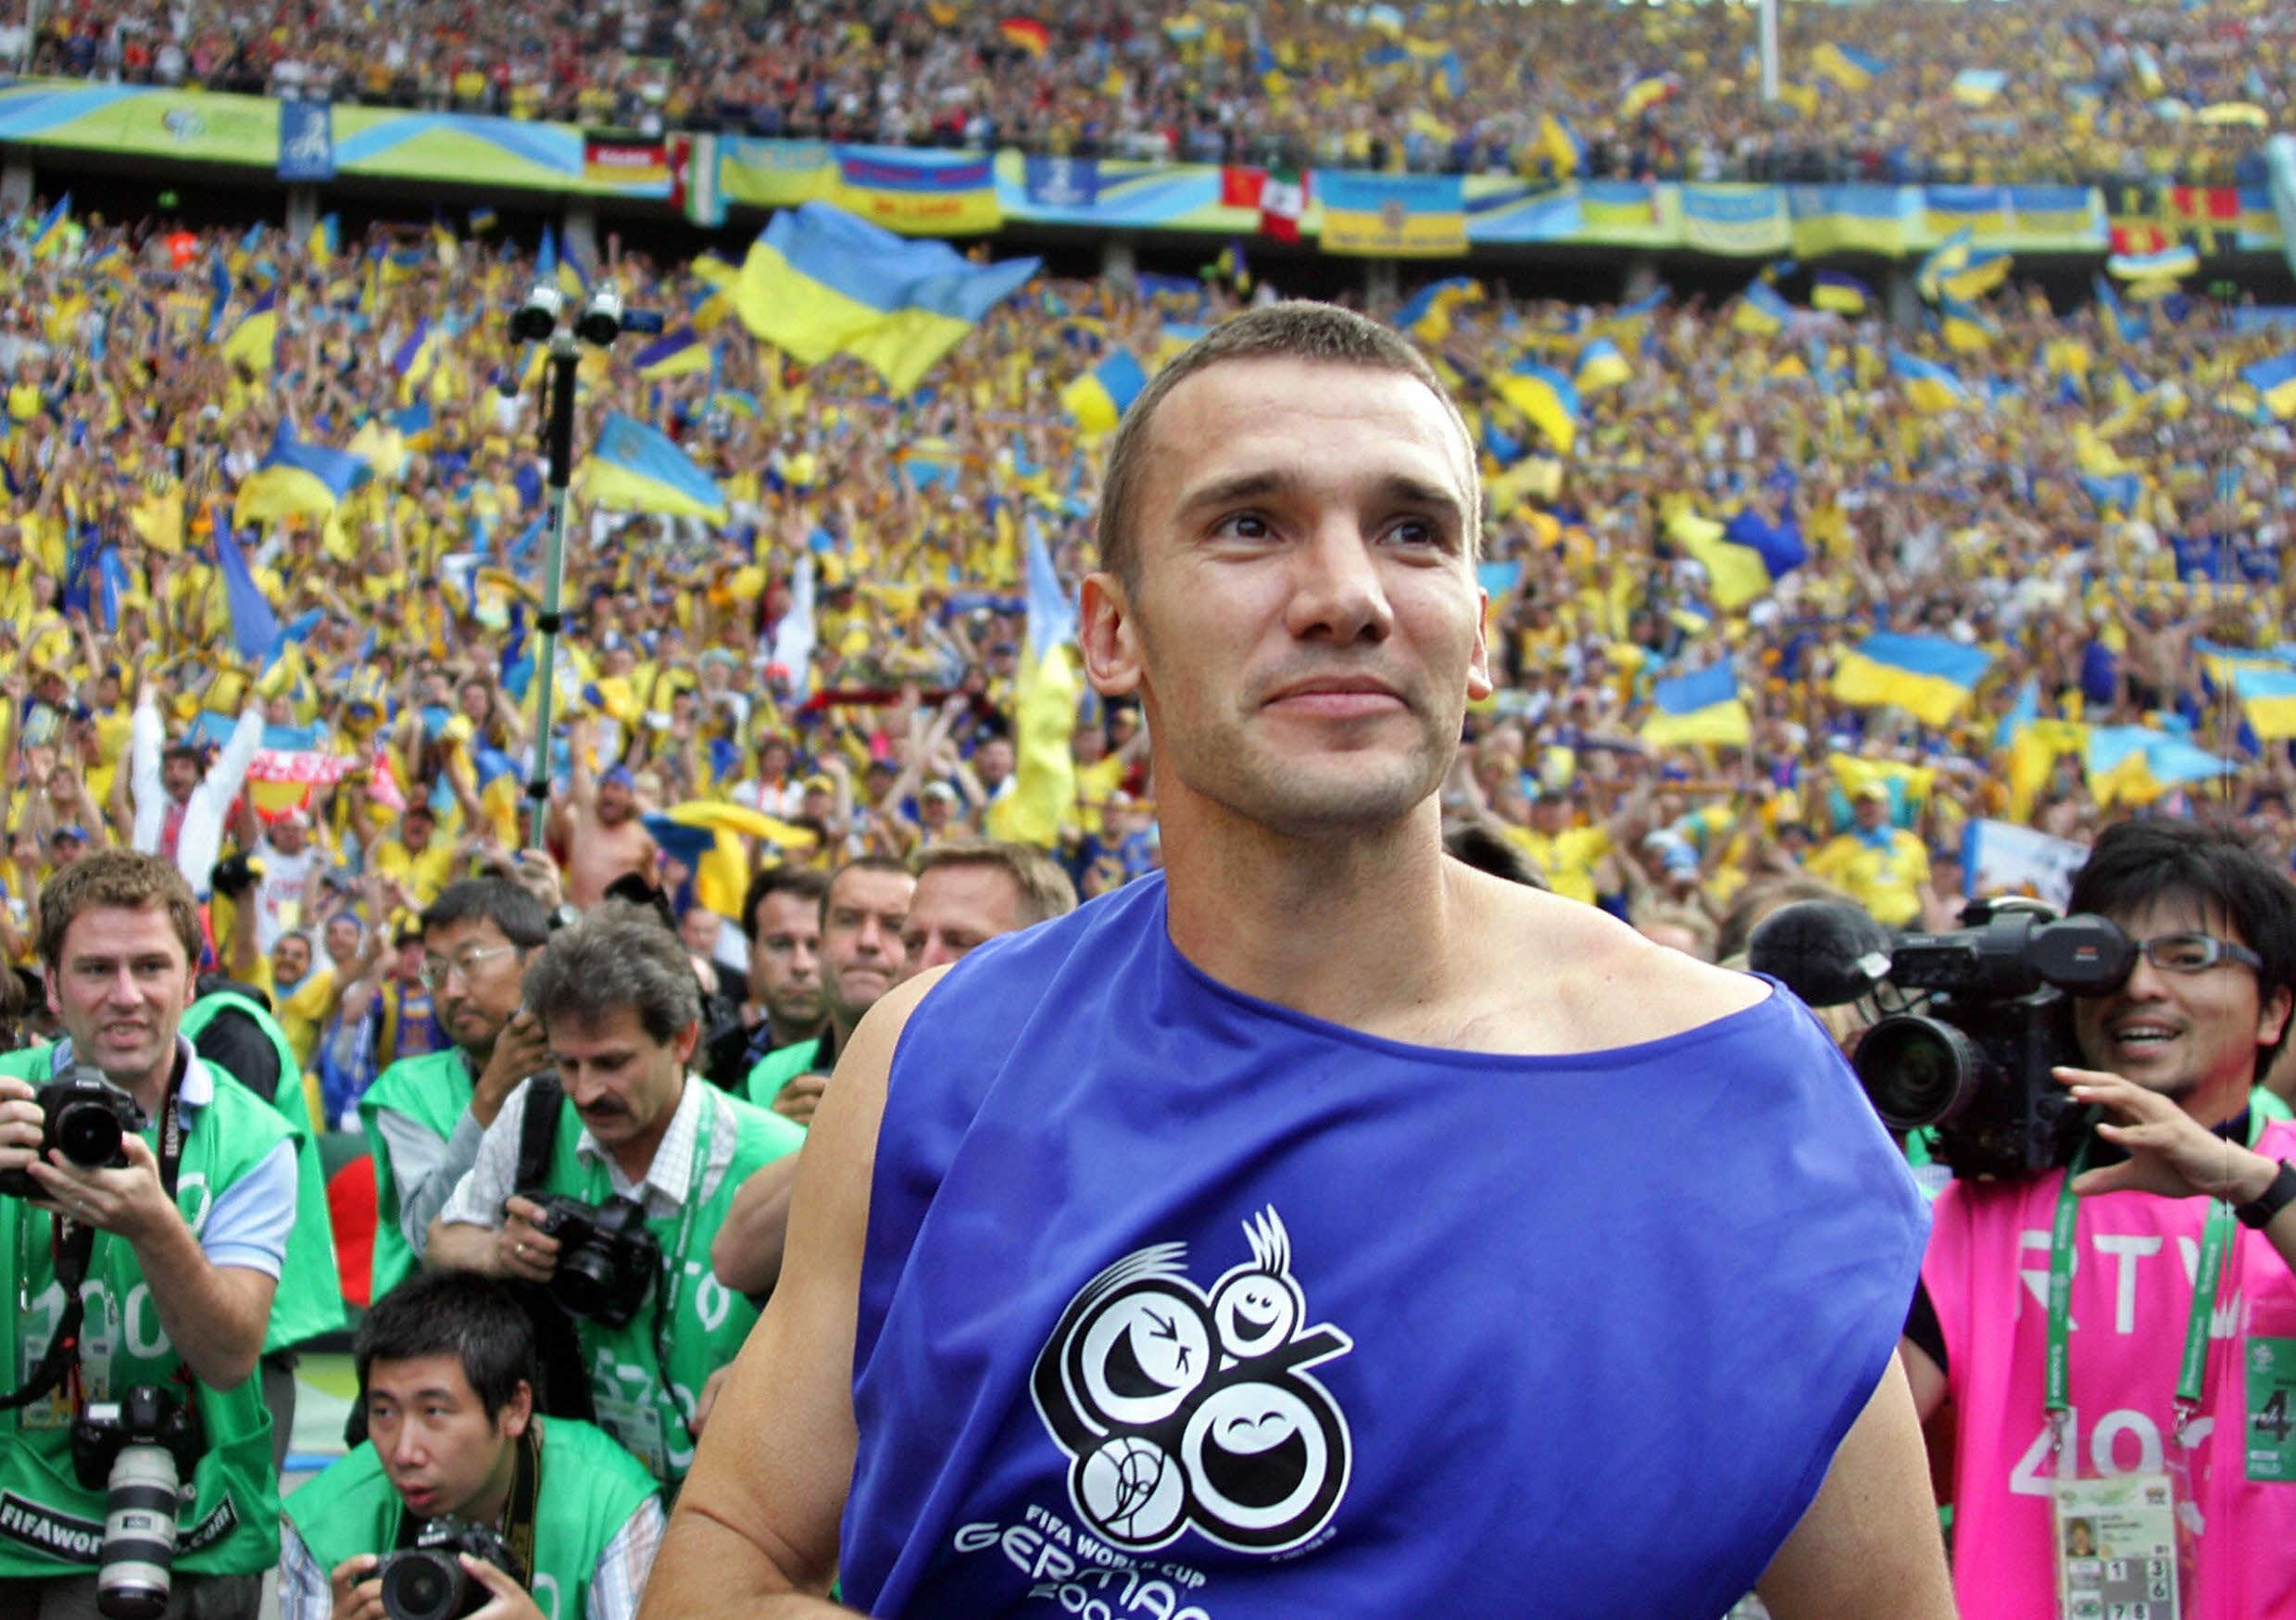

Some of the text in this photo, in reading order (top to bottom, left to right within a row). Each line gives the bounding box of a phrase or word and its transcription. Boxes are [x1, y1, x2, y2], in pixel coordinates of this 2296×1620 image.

[953, 1522, 1213, 1620] GERMA
[1024, 1503, 1072, 1547] FIFA
[1161, 1563, 1207, 1589] CUP
[1026, 1583, 1129, 1620] 200
